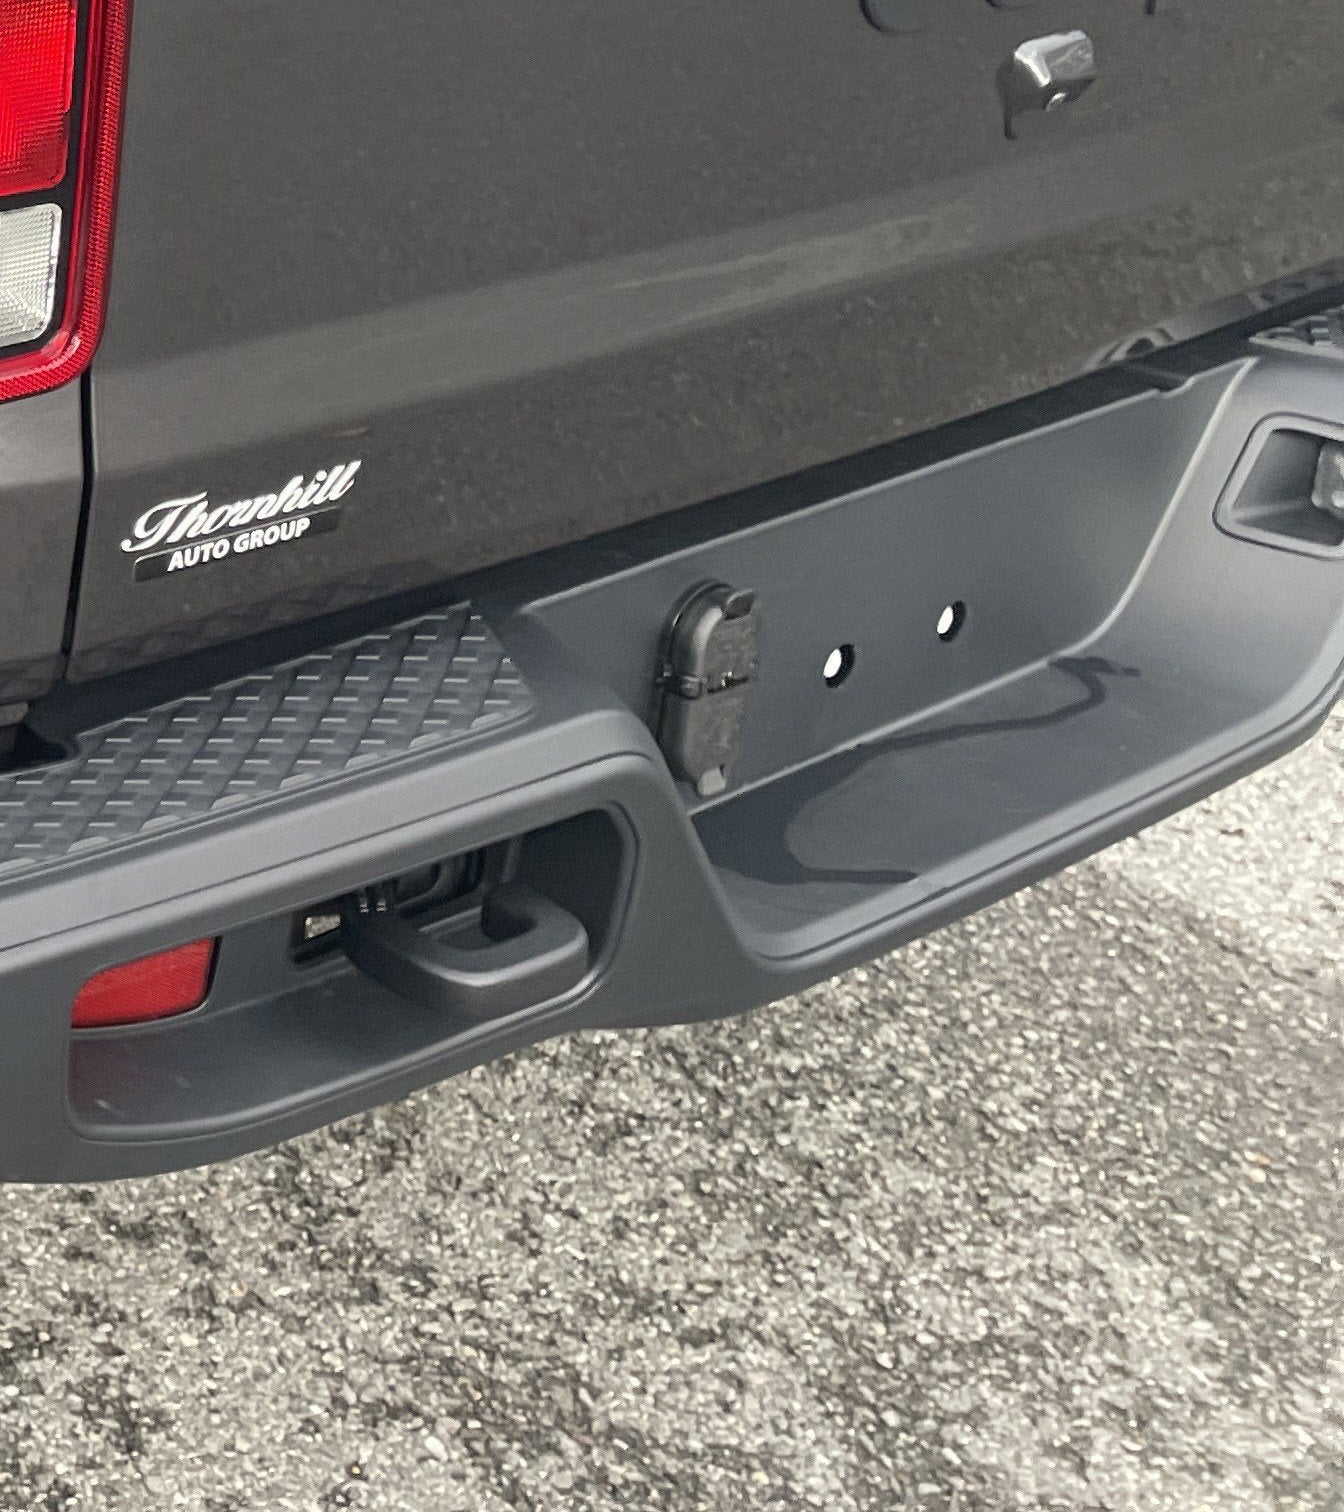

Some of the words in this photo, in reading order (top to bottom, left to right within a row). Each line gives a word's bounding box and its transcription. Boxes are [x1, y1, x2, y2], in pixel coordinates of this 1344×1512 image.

[120, 460, 362, 553] Thornhill
[166, 539, 230, 572] AUTO
[232, 517, 311, 553] GROUP
